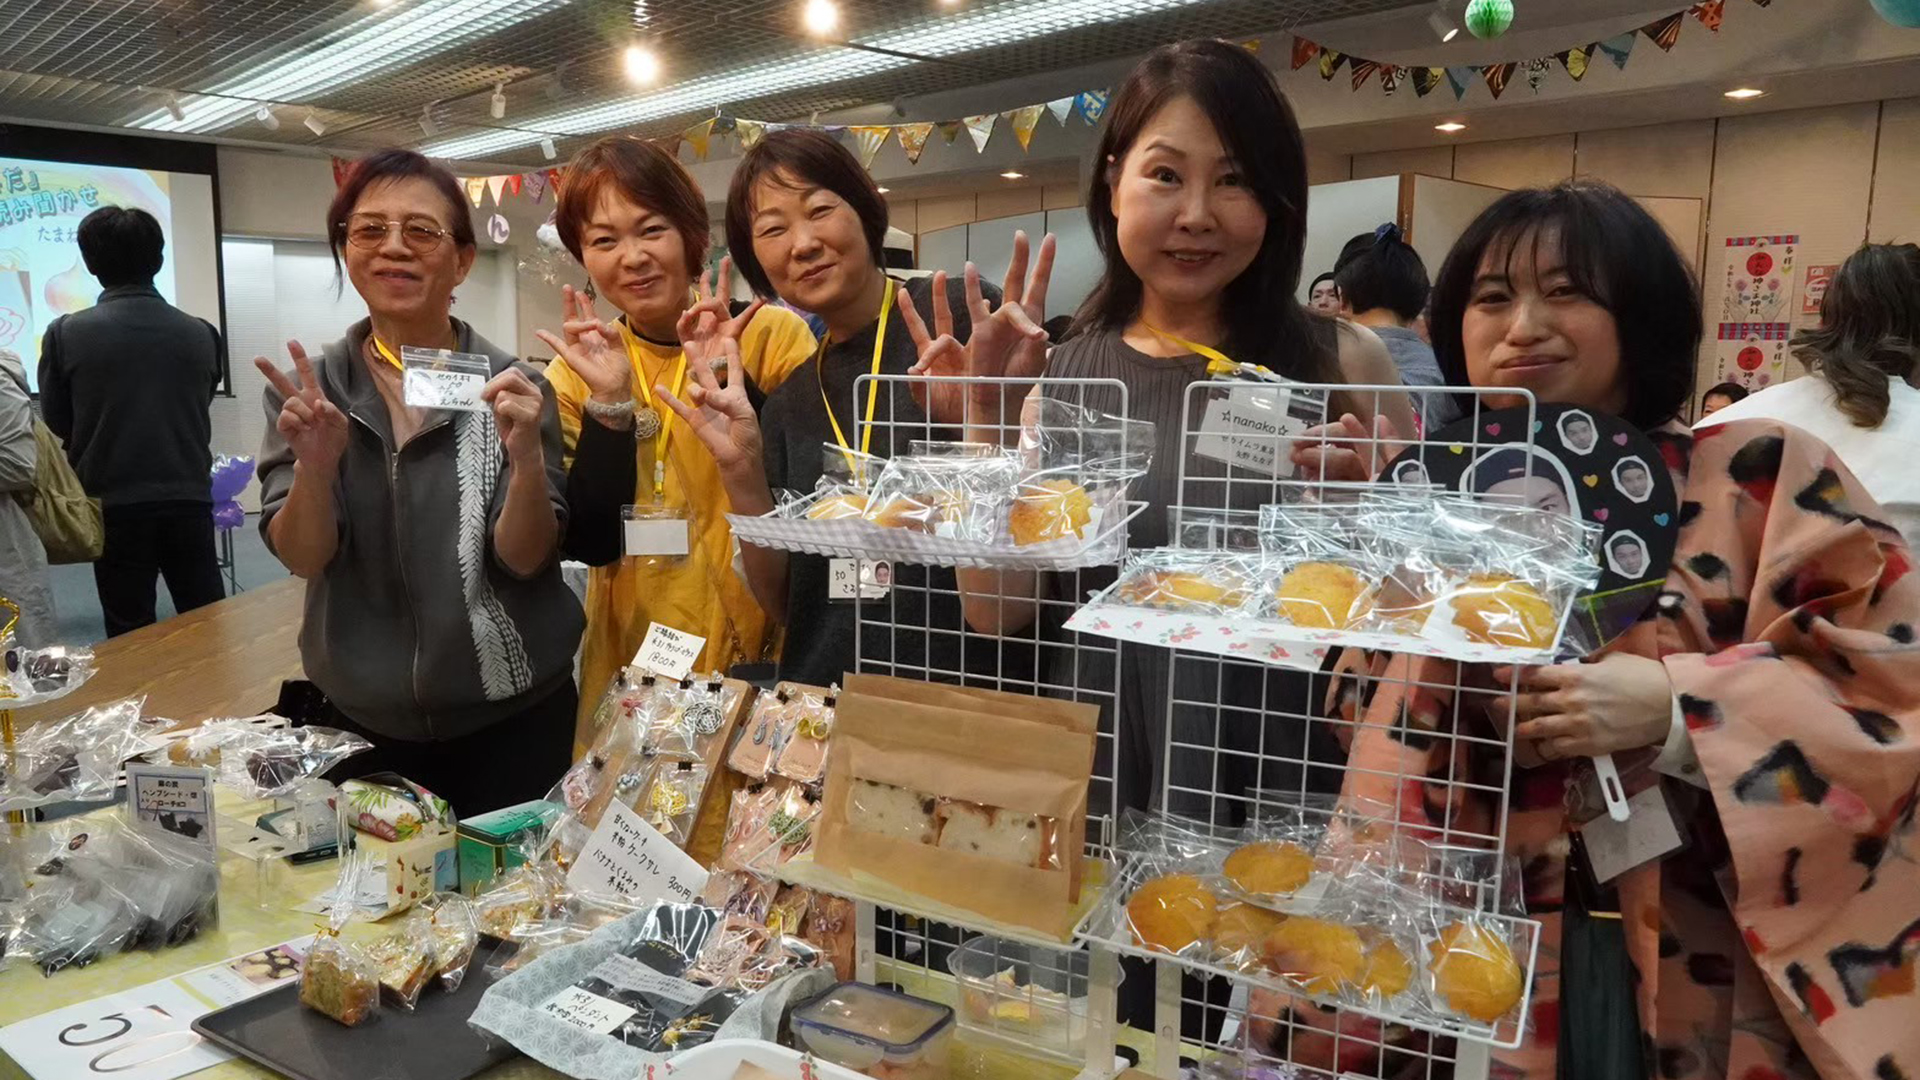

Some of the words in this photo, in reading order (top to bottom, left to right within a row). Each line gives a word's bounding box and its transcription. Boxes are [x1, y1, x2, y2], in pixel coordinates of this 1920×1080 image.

[1233, 415, 1276, 434] nanako
[647, 651, 677, 668] 1800円
[667, 875, 692, 900] 300円
